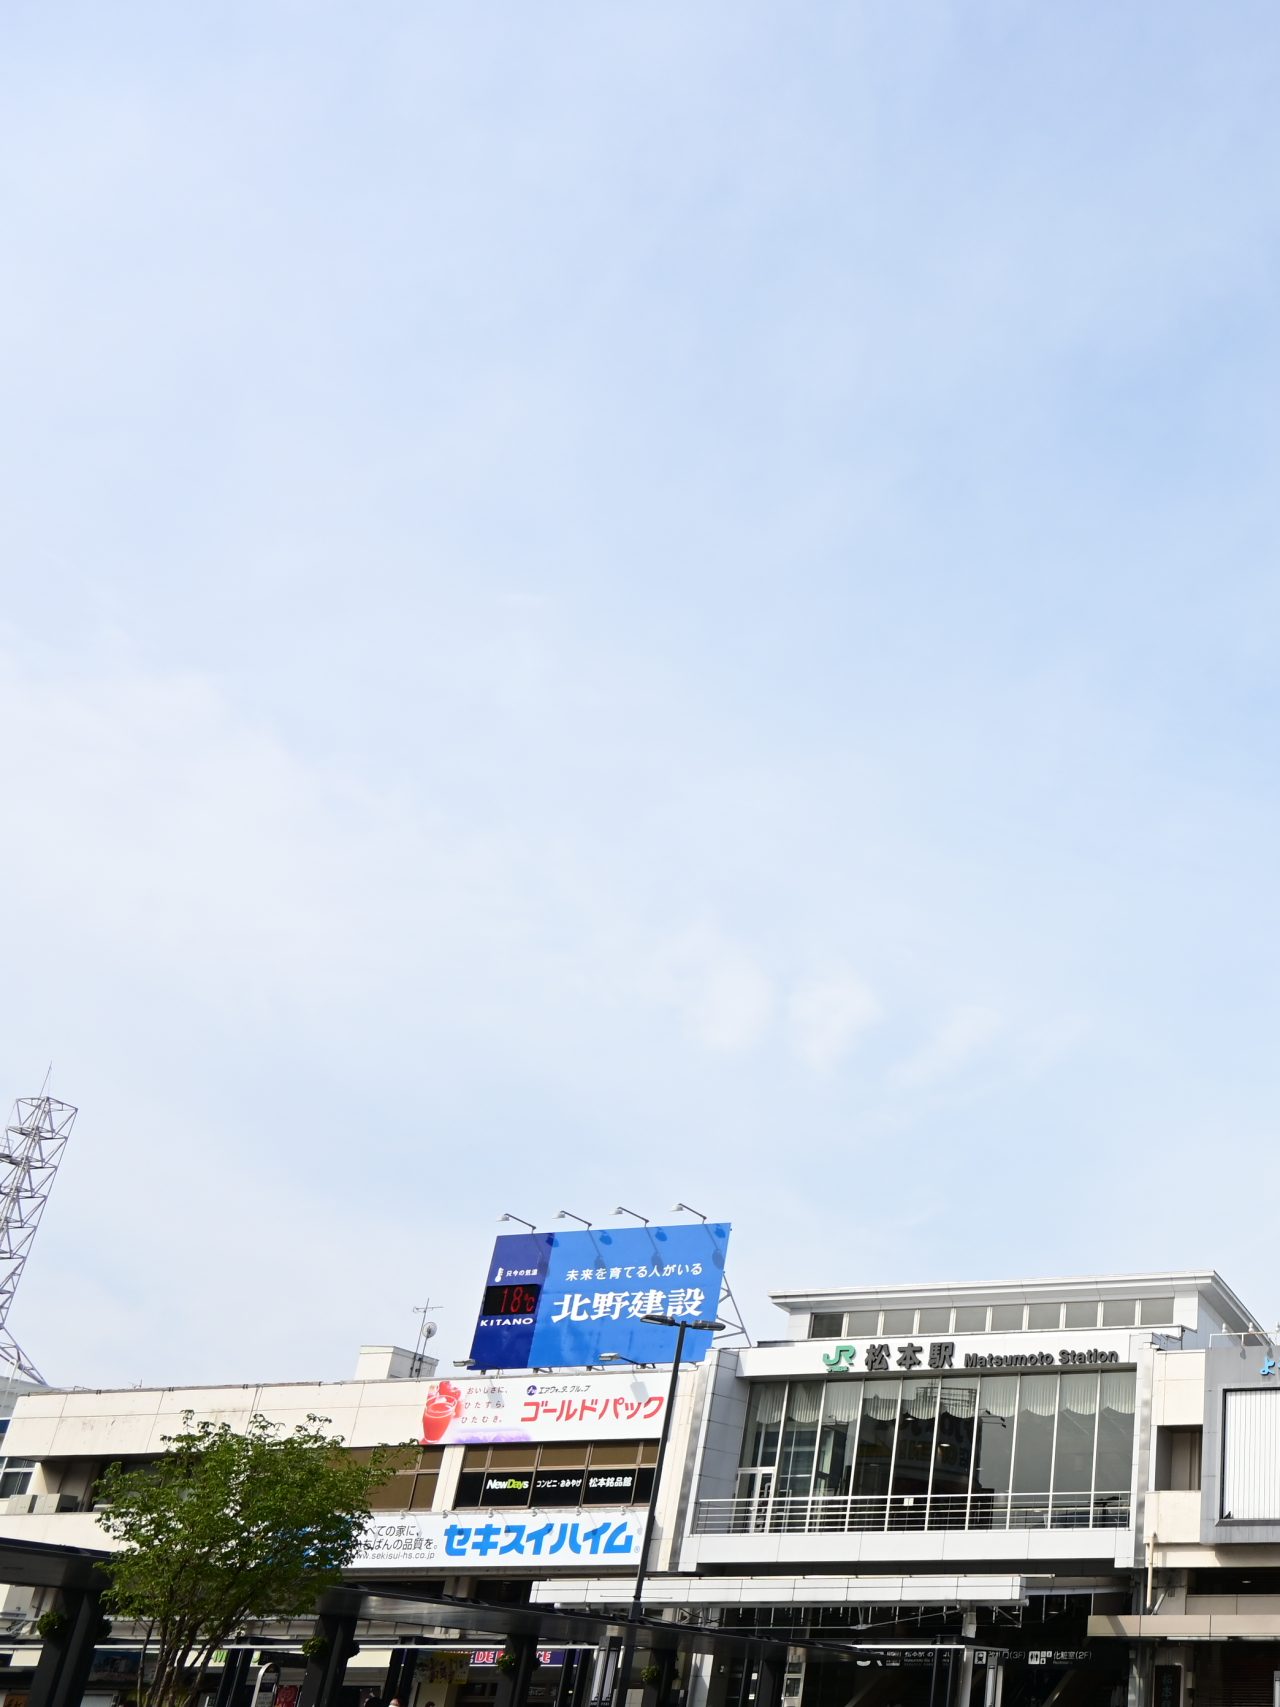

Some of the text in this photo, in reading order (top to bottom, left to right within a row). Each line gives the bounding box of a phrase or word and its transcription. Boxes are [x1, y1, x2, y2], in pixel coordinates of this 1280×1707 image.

[565, 1262, 703, 1282] 未来を育てる人がいる
[551, 1287, 705, 1324] 北野建設
[479, 1317, 534, 1327] KITANO
[822, 1345, 856, 1366] JR
[864, 1341, 955, 1371] 松本駅
[963, 1350, 1054, 1368] Matsumoto
[1058, 1348, 1119, 1365] Station
[520, 1396, 665, 1422] ゴールドパック
[486, 1479, 530, 1490] NewDays
[588, 1476, 633, 1488] 松本銘品館
[444, 1521, 634, 1557] セキスイハイム
